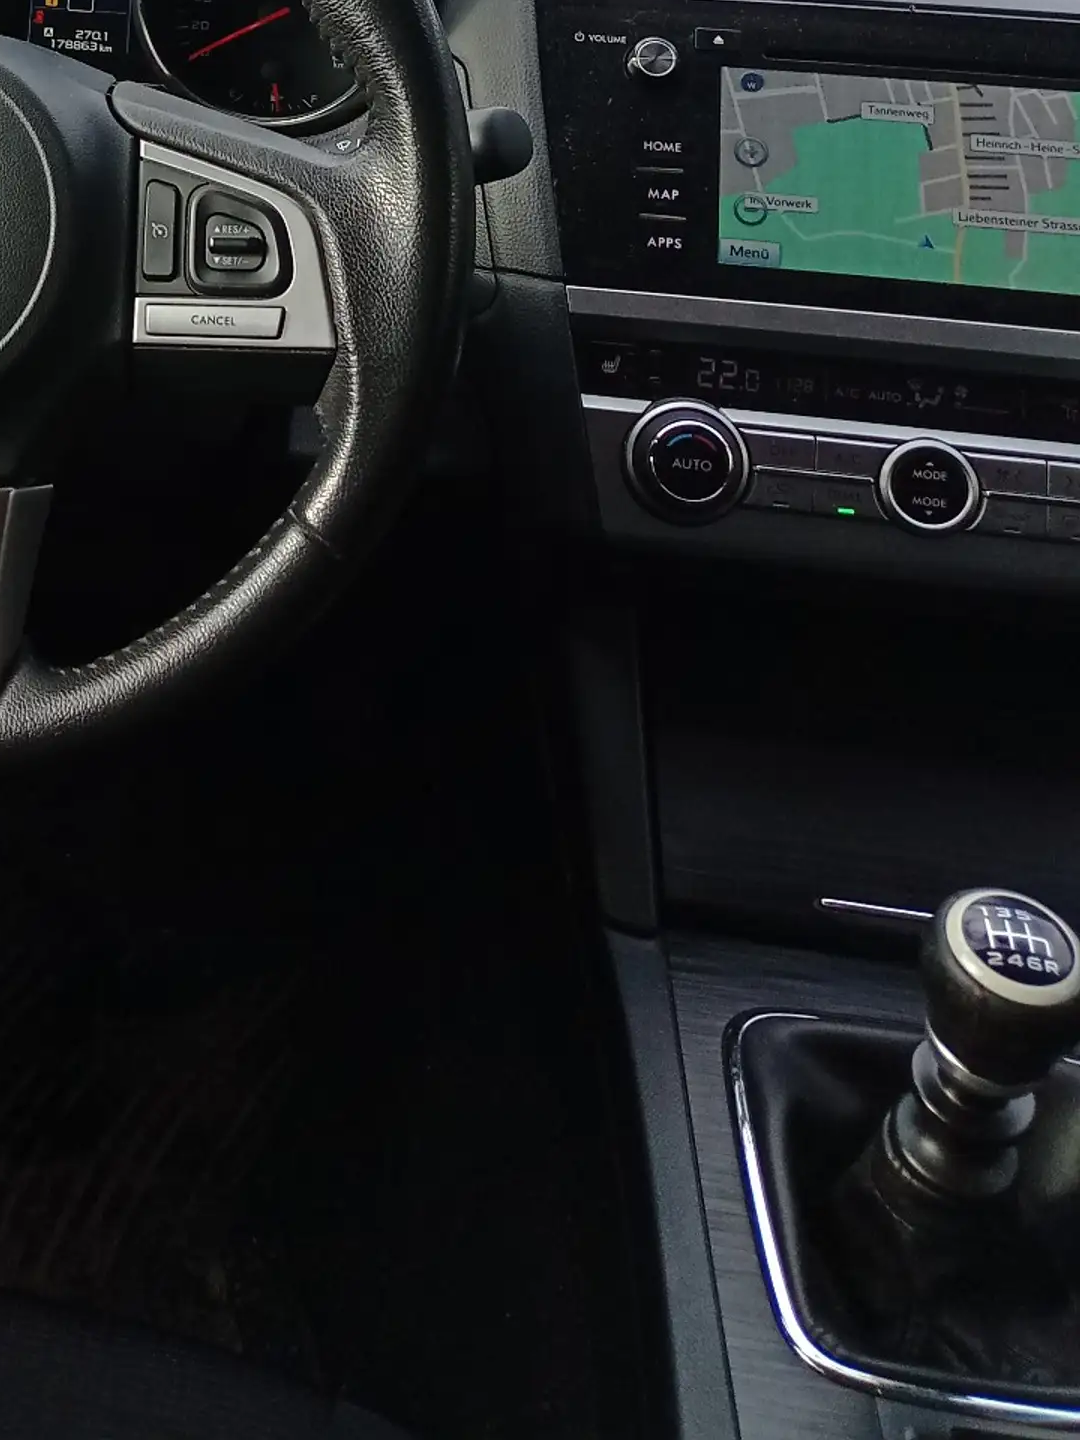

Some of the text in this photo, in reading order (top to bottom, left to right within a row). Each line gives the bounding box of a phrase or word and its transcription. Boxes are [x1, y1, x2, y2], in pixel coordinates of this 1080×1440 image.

[191, 20, 210, 31] 20
[51, 39, 113, 53] 178863 km
[588, 34, 627, 45] VOLUME
[746, 82, 757, 90] W
[869, 105, 930, 121] Tannenweg
[643, 141, 682, 152] HOME
[648, 189, 680, 200] MAP
[767, 196, 813, 210] Vorwerk
[958, 211, 1039, 227] Liebensteiner
[647, 236, 683, 249] APPS
[730, 245, 770, 260] Menü
[190, 315, 236, 327] CANCEL
[697, 356, 760, 392] 22.0
[869, 391, 903, 405] AUTO
[672, 458, 713, 472] AUTO
[912, 468, 948, 482] MODE
[912, 496, 947, 508] MODE
[995, 906, 1011, 919] 3
[1015, 909, 1032, 921] 5
[986, 951, 1060, 976] 2 4 6 R
